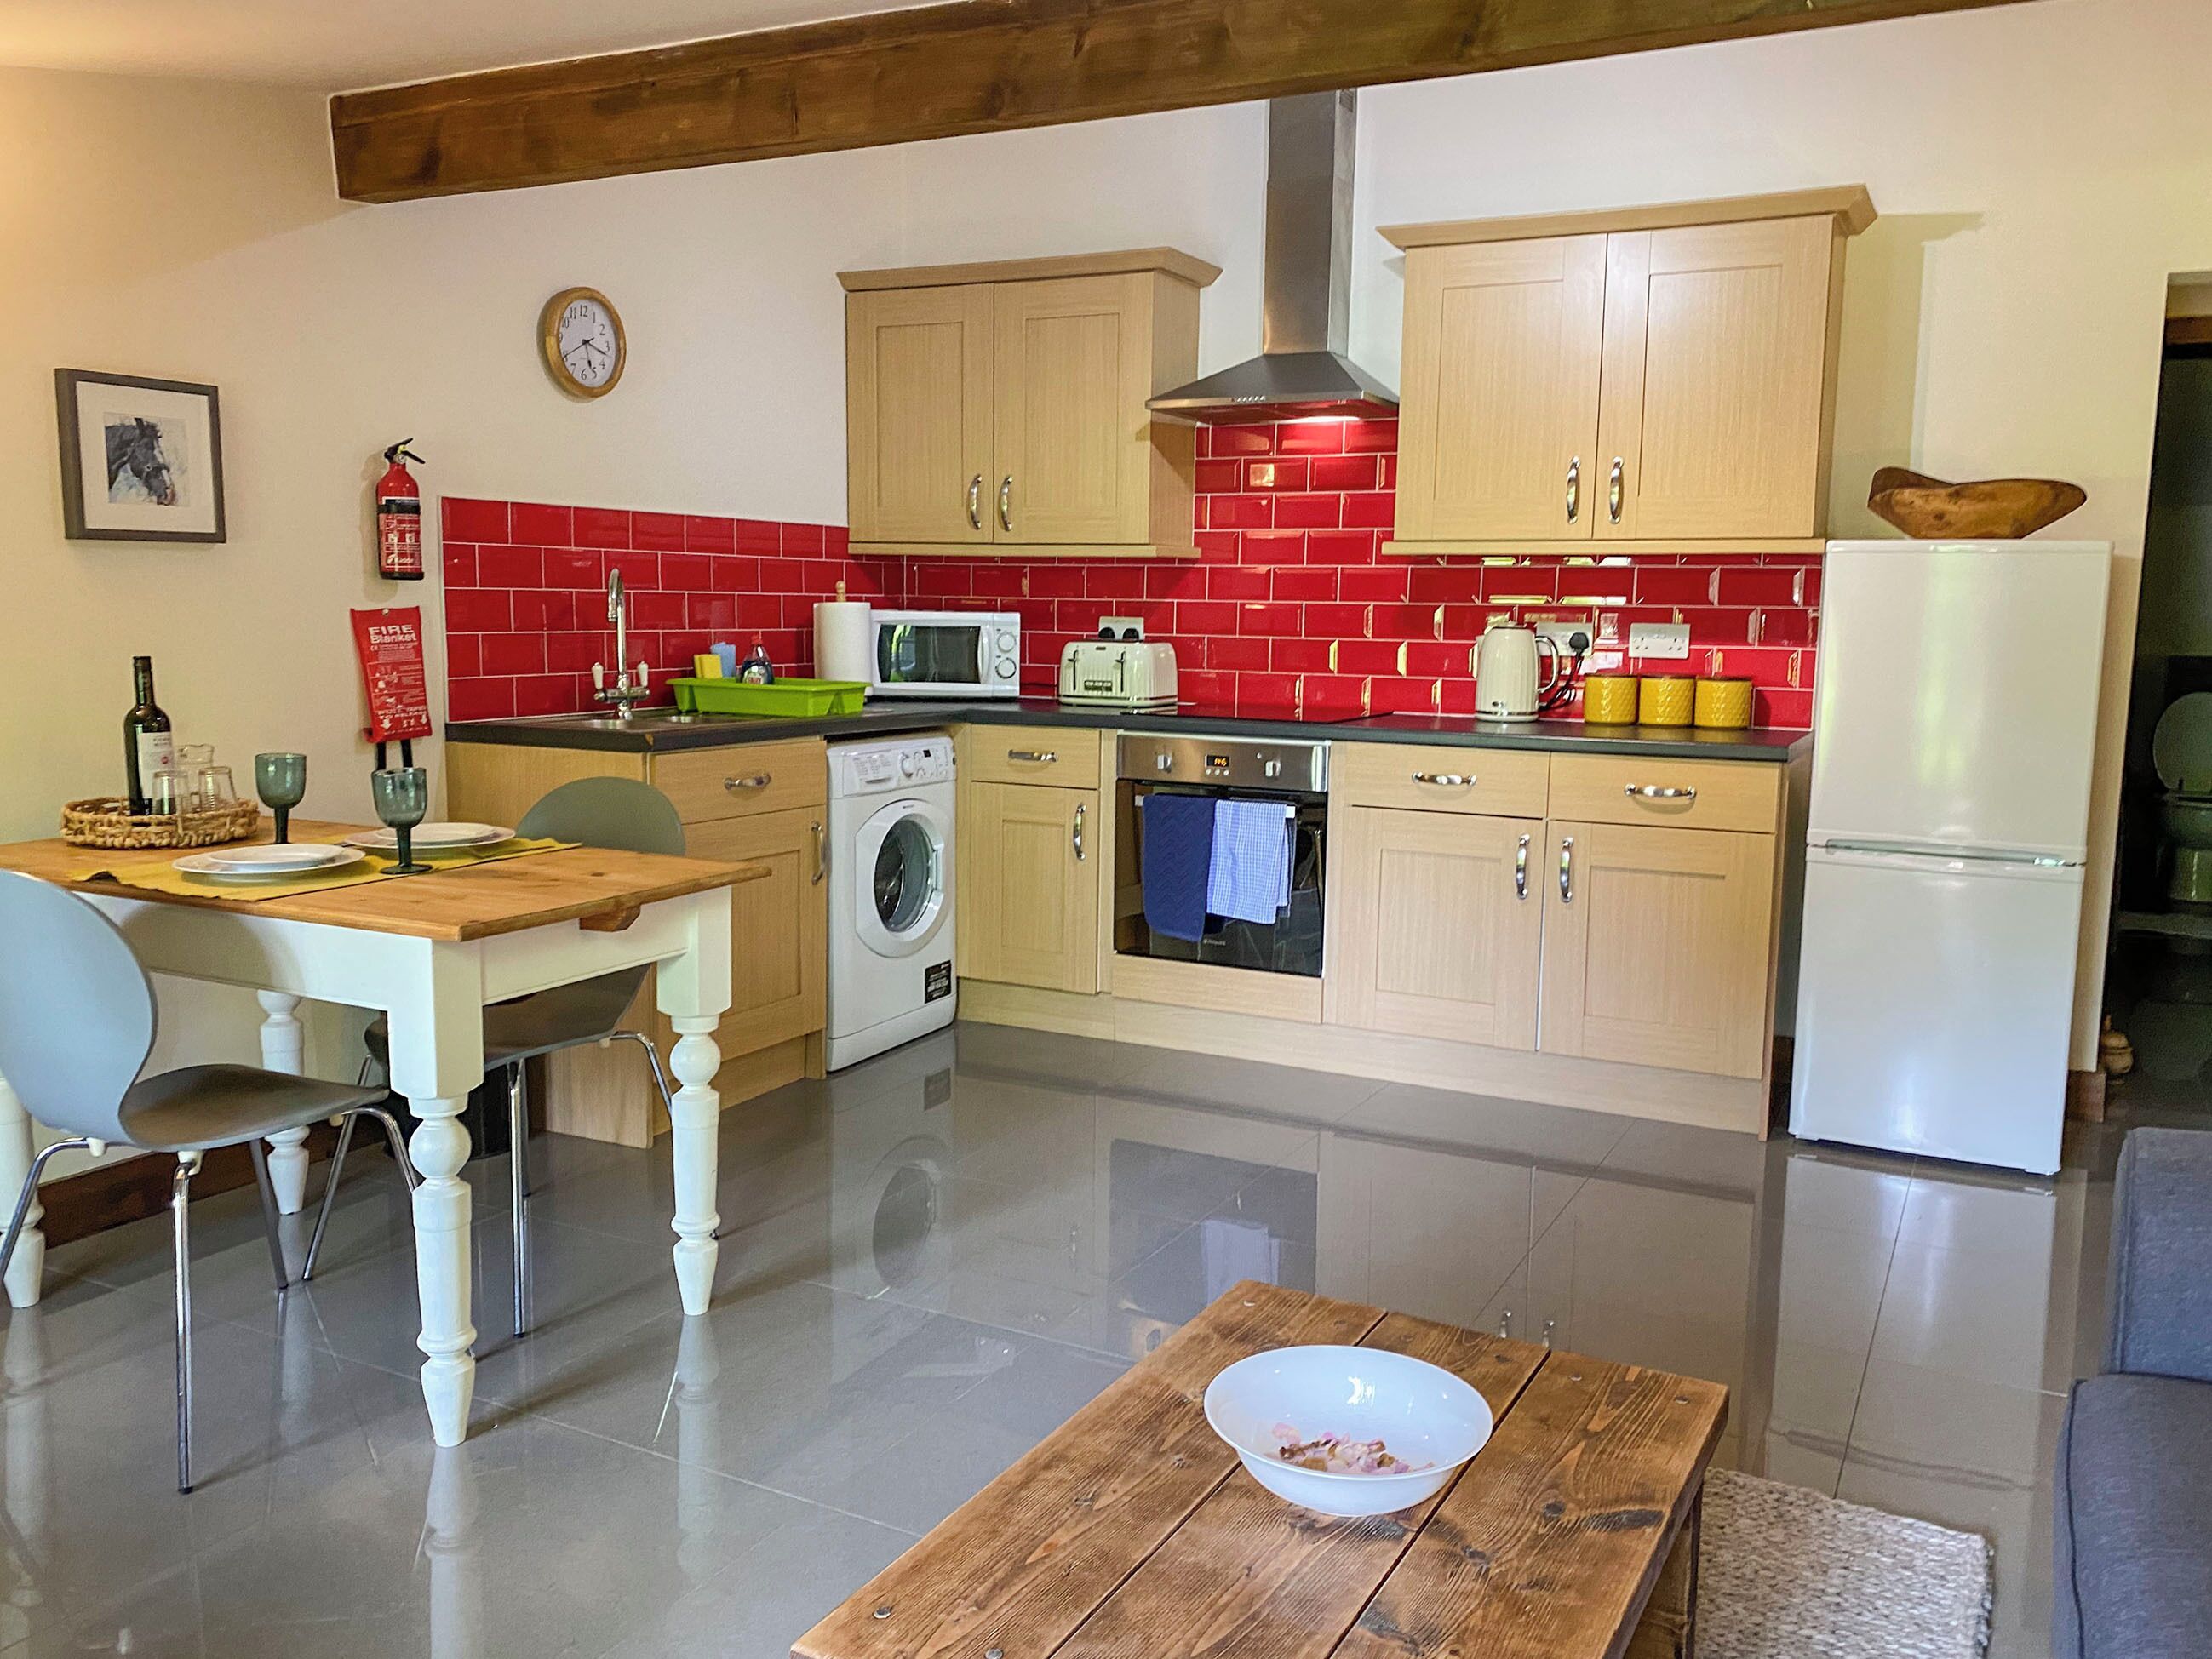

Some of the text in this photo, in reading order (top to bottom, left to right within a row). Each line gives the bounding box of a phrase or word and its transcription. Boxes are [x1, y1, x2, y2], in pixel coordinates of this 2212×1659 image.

[570, 306, 576, 320] 11
[579, 304, 588, 317] 12
[593, 311, 596, 323] 1
[599, 323, 605, 335] 2
[605, 340, 610, 352] 3
[570, 363, 576, 375] 7
[599, 358, 605, 369] 4
[581, 368, 587, 380] 6
[592, 367, 598, 380] 5
[368, 624, 414, 635] FIRE
[370, 632, 417, 644] Blanket
